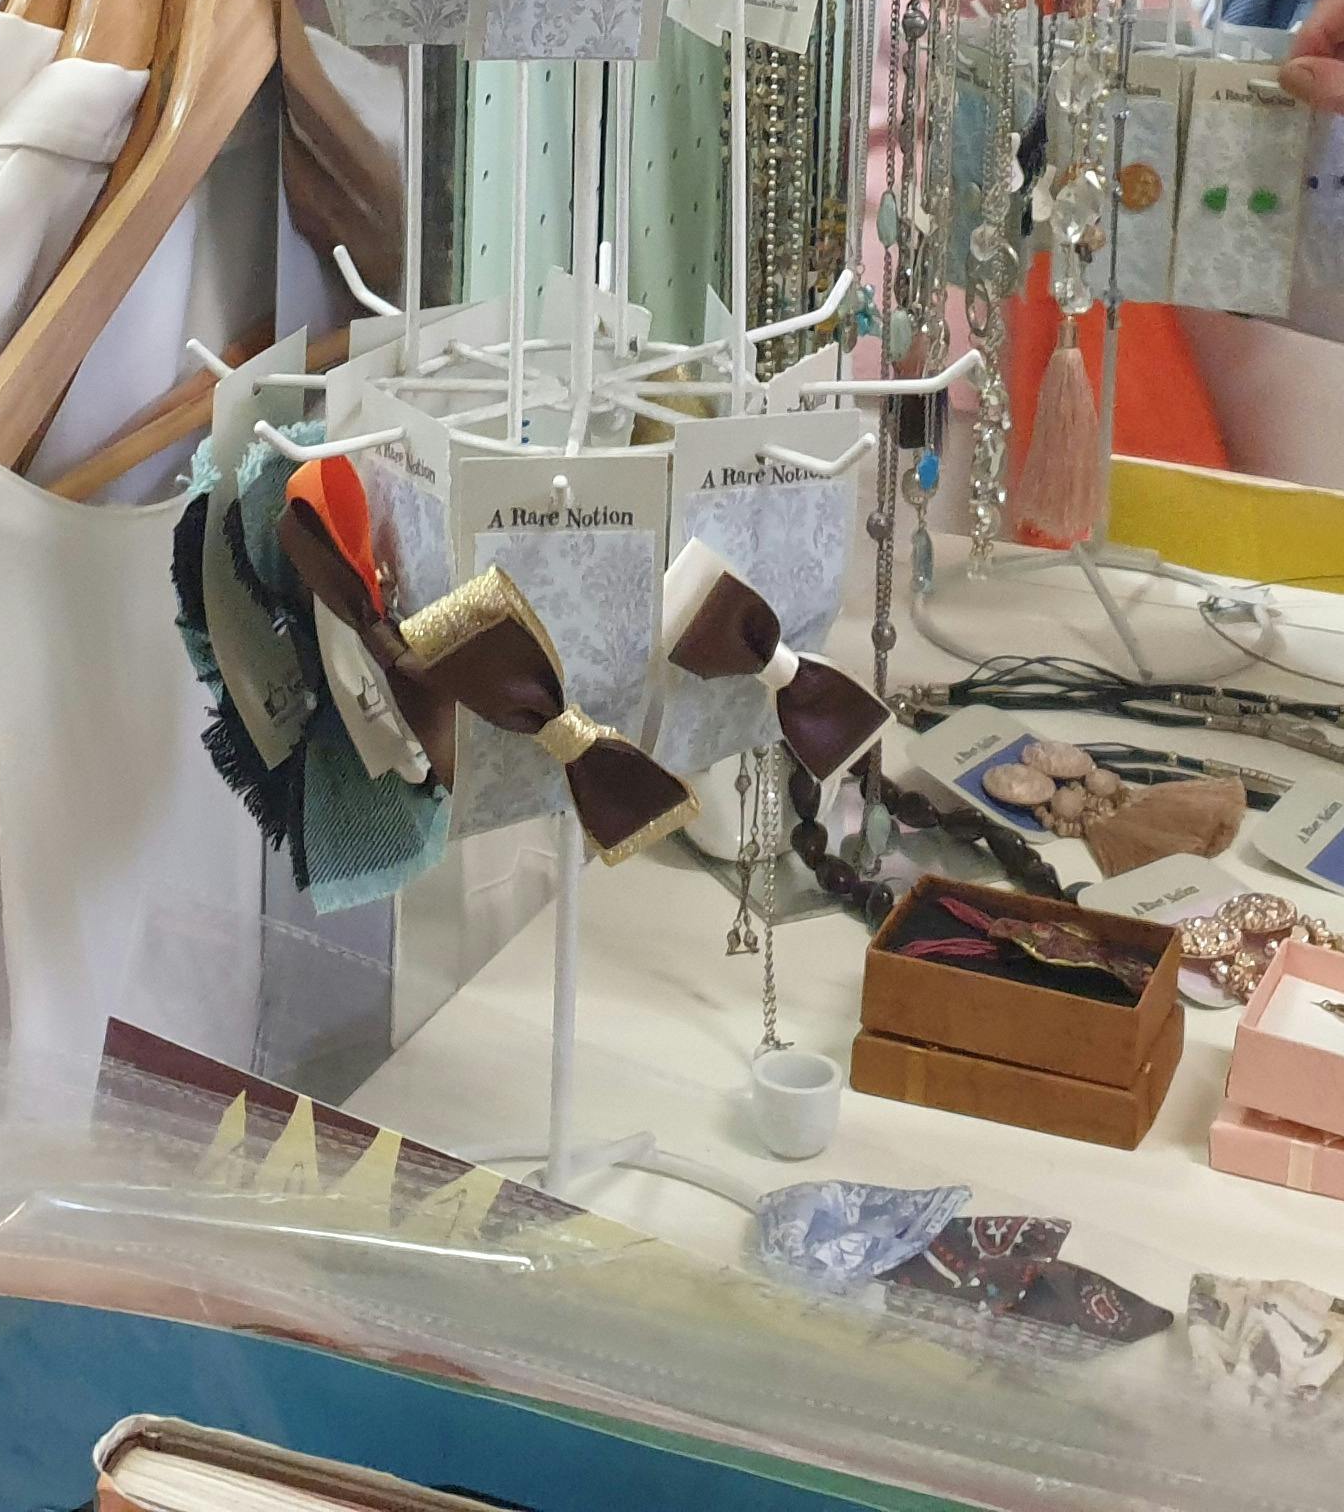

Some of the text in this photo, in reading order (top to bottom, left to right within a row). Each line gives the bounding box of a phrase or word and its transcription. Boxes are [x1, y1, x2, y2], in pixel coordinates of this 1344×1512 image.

[383, 442, 404, 467] Rare
[405, 454, 436, 485] Notion
[701, 469, 716, 490] A
[720, 466, 767, 486] Rare
[487, 505, 634, 530] A Rare Notion
